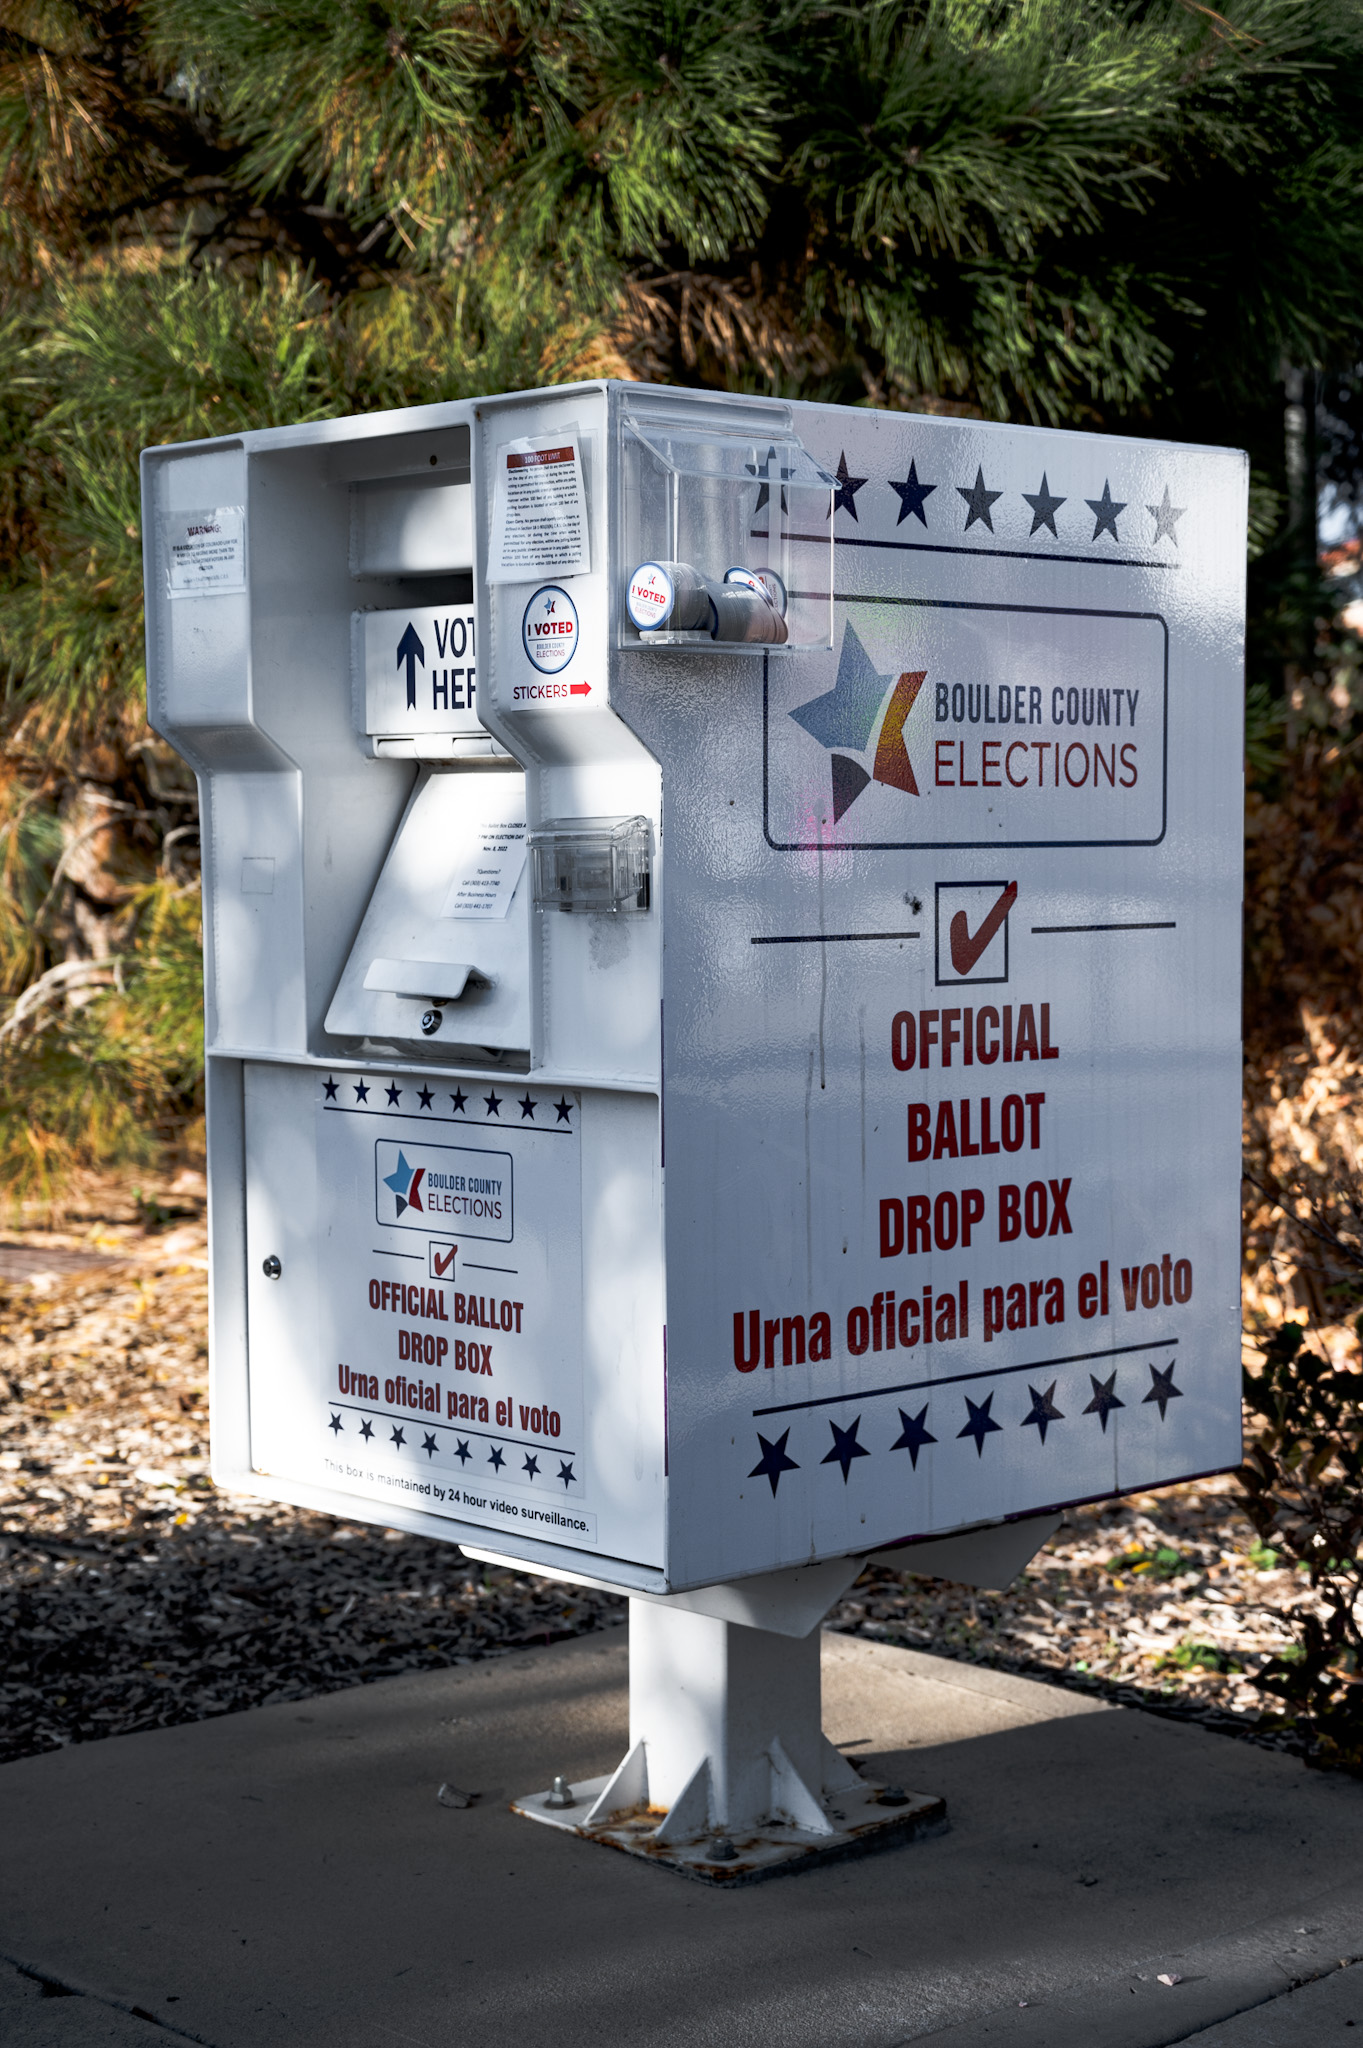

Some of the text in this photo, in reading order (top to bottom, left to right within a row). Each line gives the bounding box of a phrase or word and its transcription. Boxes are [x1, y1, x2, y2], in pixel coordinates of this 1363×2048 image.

[534, 454, 547, 462] FOOT
[632, 585, 666, 604] I VOTED
[434, 617, 476, 658] VOT
[528, 621, 573, 636] I VOTED
[536, 649, 565, 658] ELECTIONS
[513, 684, 568, 700] STICKERS
[935, 682, 1139, 727] BOULDER COUNTY
[934, 740, 1138, 788] ELECTIONS
[891, 1002, 1059, 1072] OFFICIAL
[907, 1092, 1046, 1163] BALLOT
[428, 1172, 502, 1196] BOULDER COUNTY
[428, 1193, 502, 1220] ELECTIONS
[879, 1177, 1074, 1258] DROP BOX
[368, 1278, 524, 1334] OFFICIAL BALLOT
[733, 1253, 1193, 1373] Urna oficial para el voto
[398, 1329, 493, 1377] DROP BOX
[338, 1363, 561, 1438] Urna oficial para el voto
[325, 1458, 589, 1532] This box is maintained by 24 hour video surveillance.
